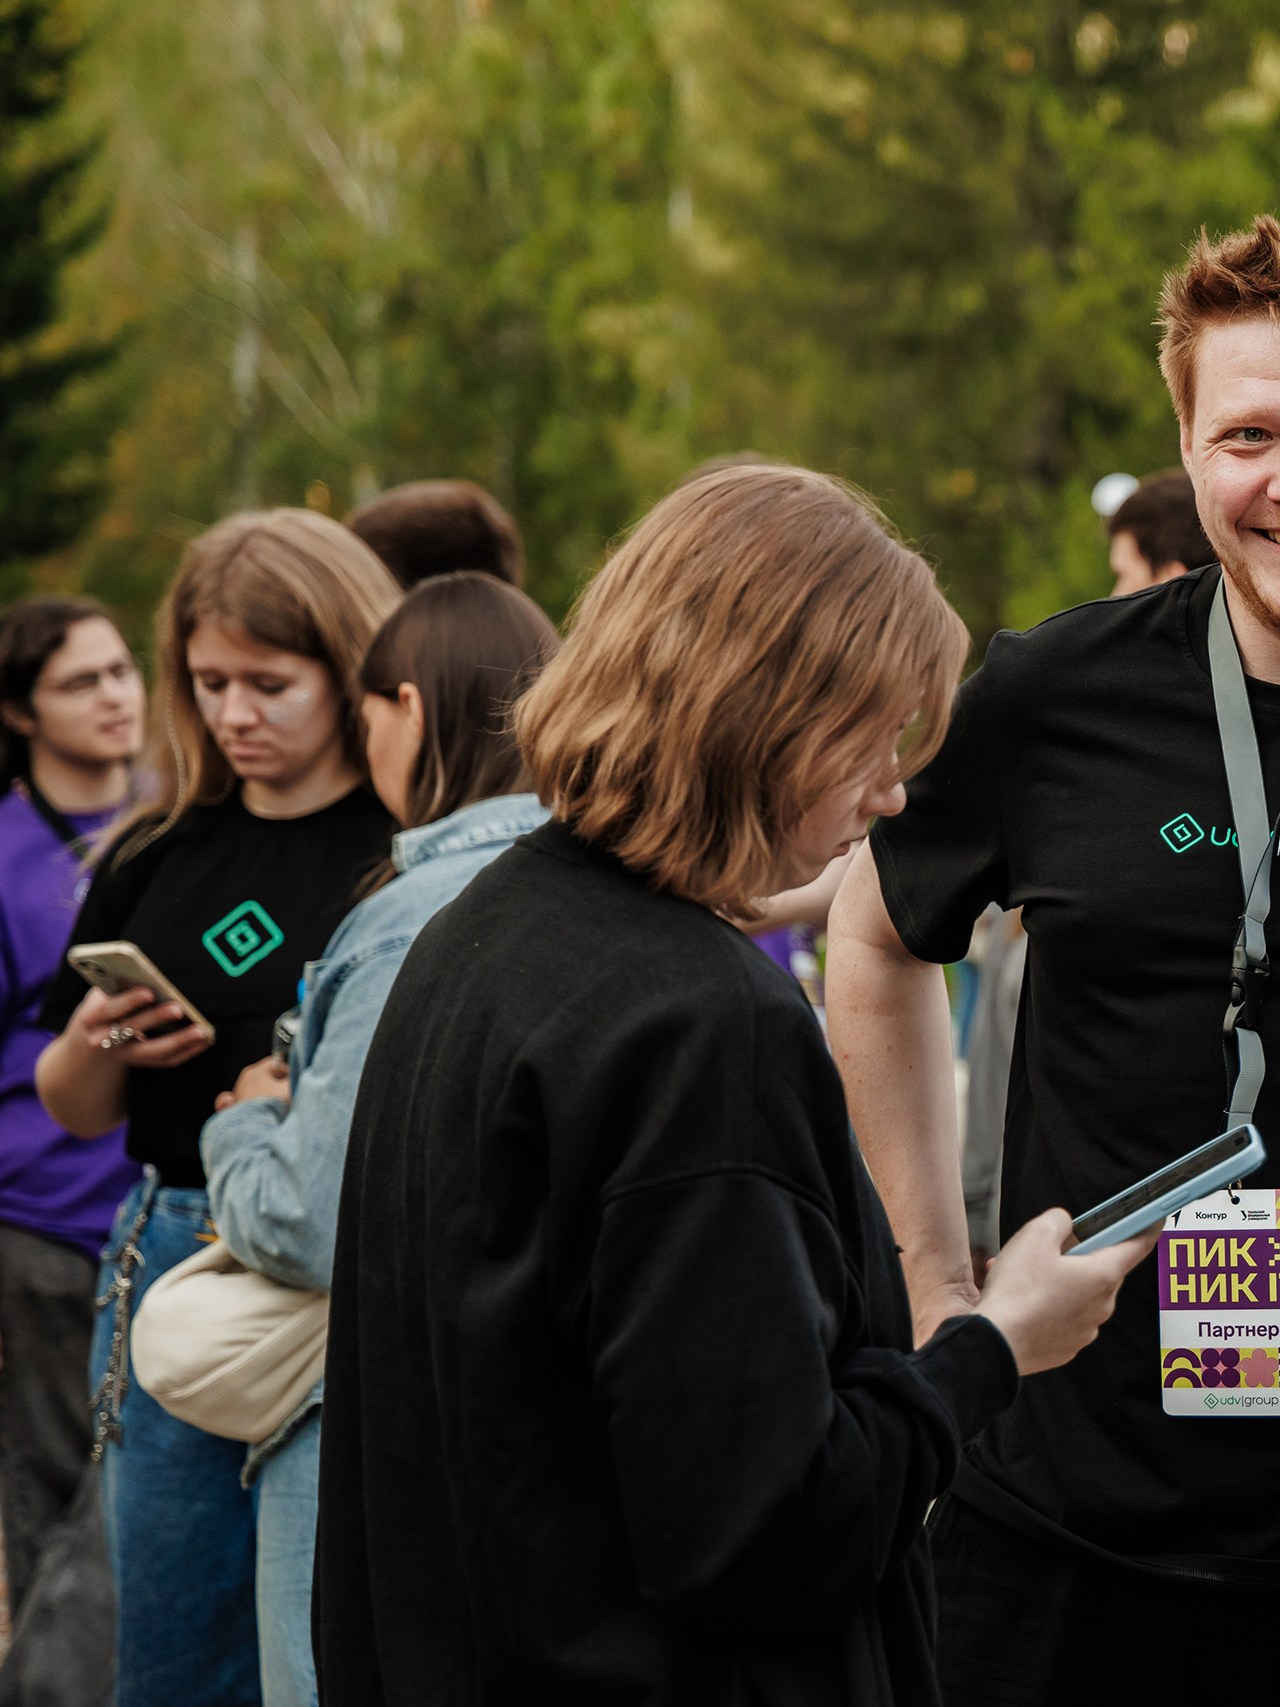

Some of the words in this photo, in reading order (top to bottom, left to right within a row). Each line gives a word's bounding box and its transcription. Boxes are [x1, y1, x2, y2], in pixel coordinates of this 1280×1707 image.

[1195, 1211, 1227, 1220] Контур
[1169, 1237, 1258, 1268] ПИК
[1169, 1273, 1259, 1303] НИК
[1198, 1321, 1280, 1340] Партнер
